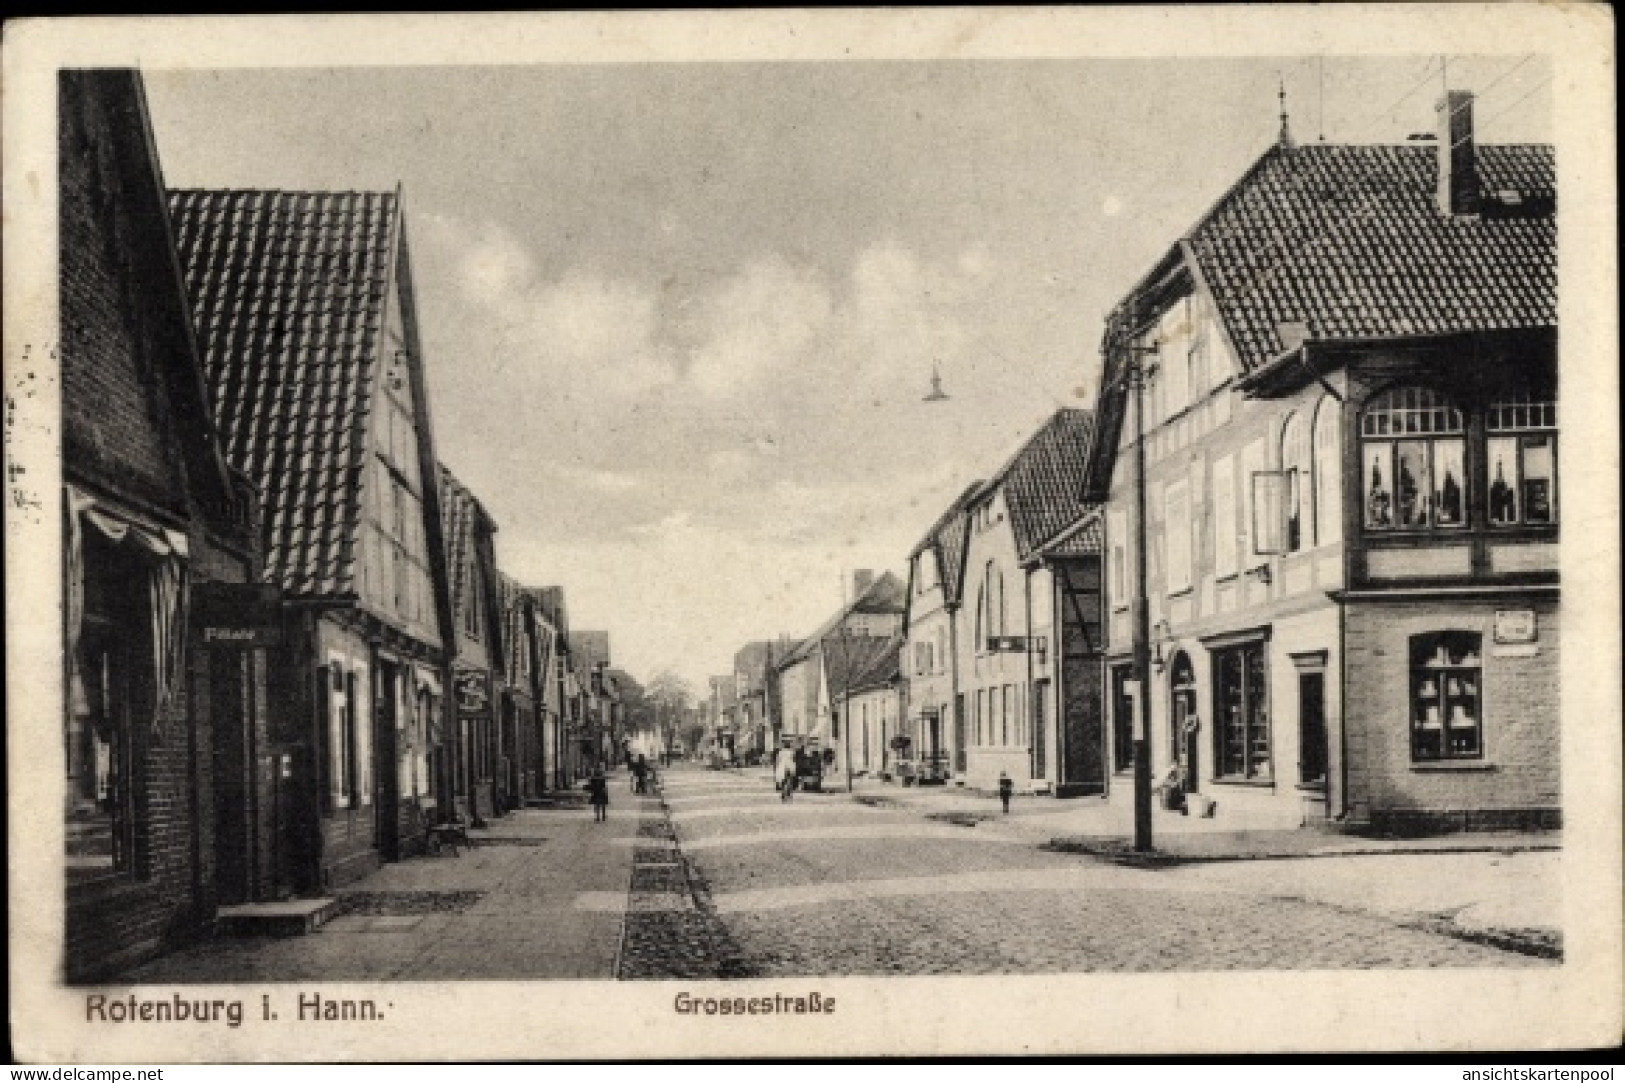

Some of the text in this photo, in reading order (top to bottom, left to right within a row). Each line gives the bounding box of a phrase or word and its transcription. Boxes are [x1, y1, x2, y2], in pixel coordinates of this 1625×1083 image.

[85, 992, 242, 1028] Rotenburg
[299, 993, 385, 1021] Hann.
[674, 991, 836, 1016] Grossestraße
